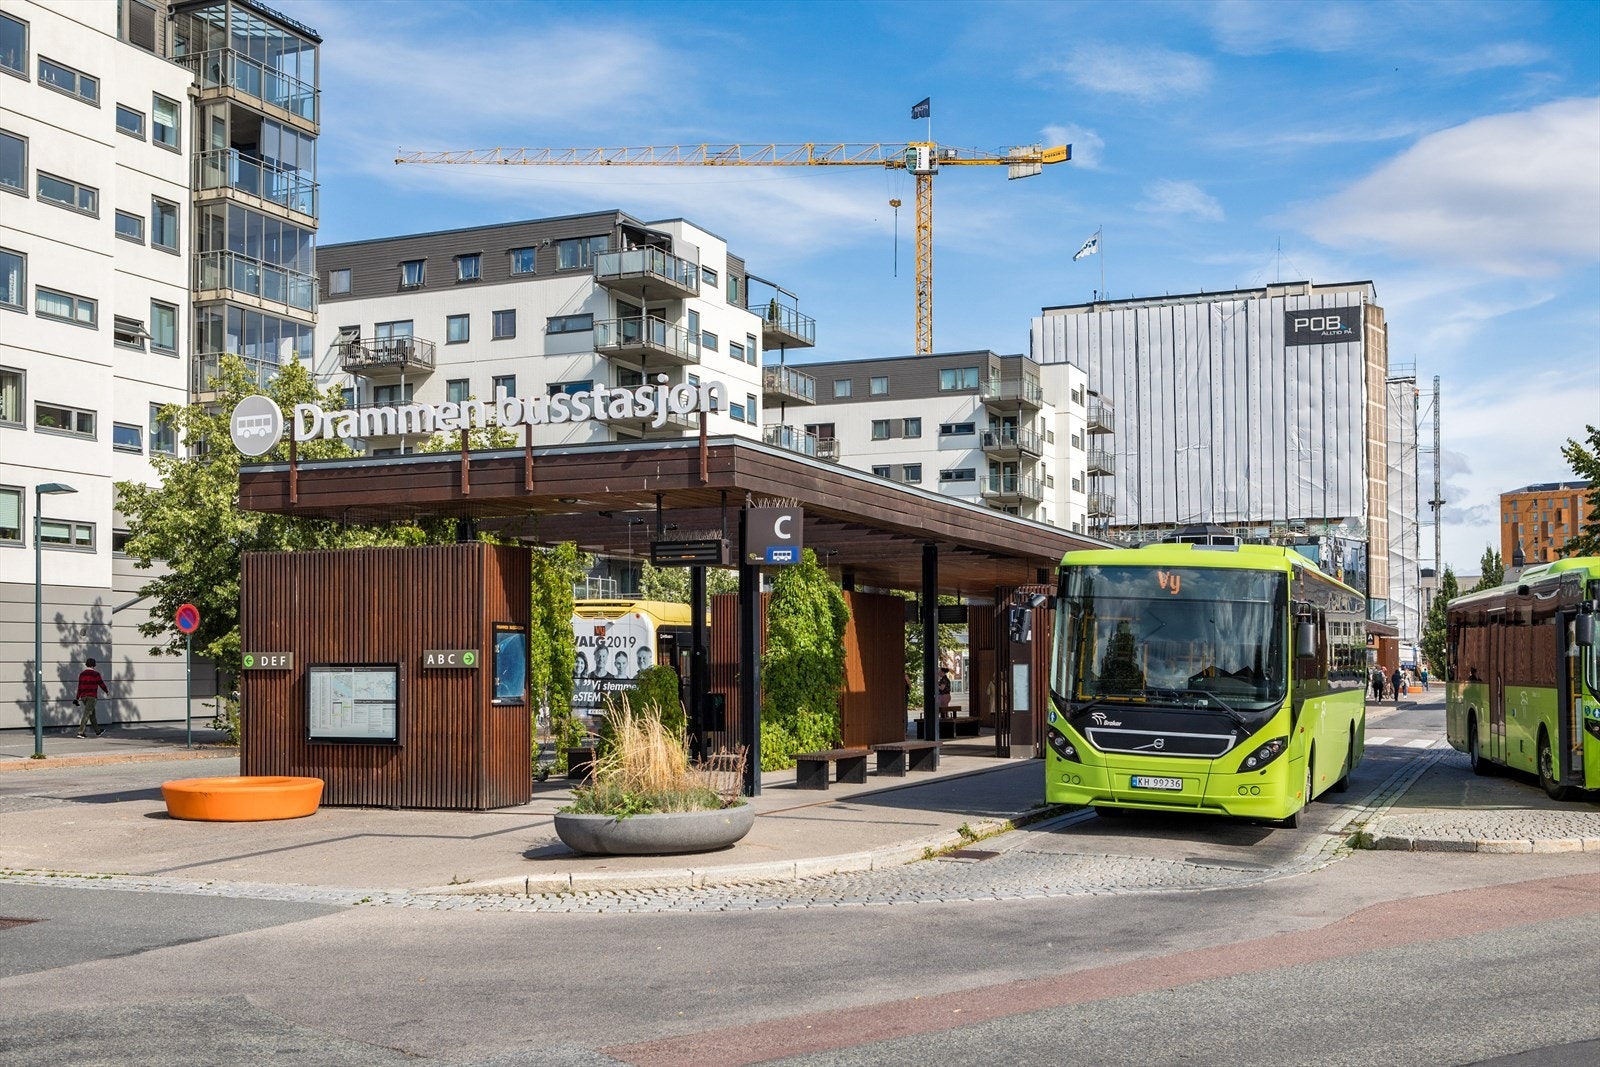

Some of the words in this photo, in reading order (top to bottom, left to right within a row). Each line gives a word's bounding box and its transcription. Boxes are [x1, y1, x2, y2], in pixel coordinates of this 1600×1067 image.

[1294, 316, 1341, 332] POB
[294, 399, 486, 441] Drammen
[497, 373, 729, 428] busstasjon
[774, 515, 792, 539] C
[1157, 571, 1181, 595] Vy
[1137, 777, 1150, 786] KH
[1153, 778, 1181, 788] 99236
